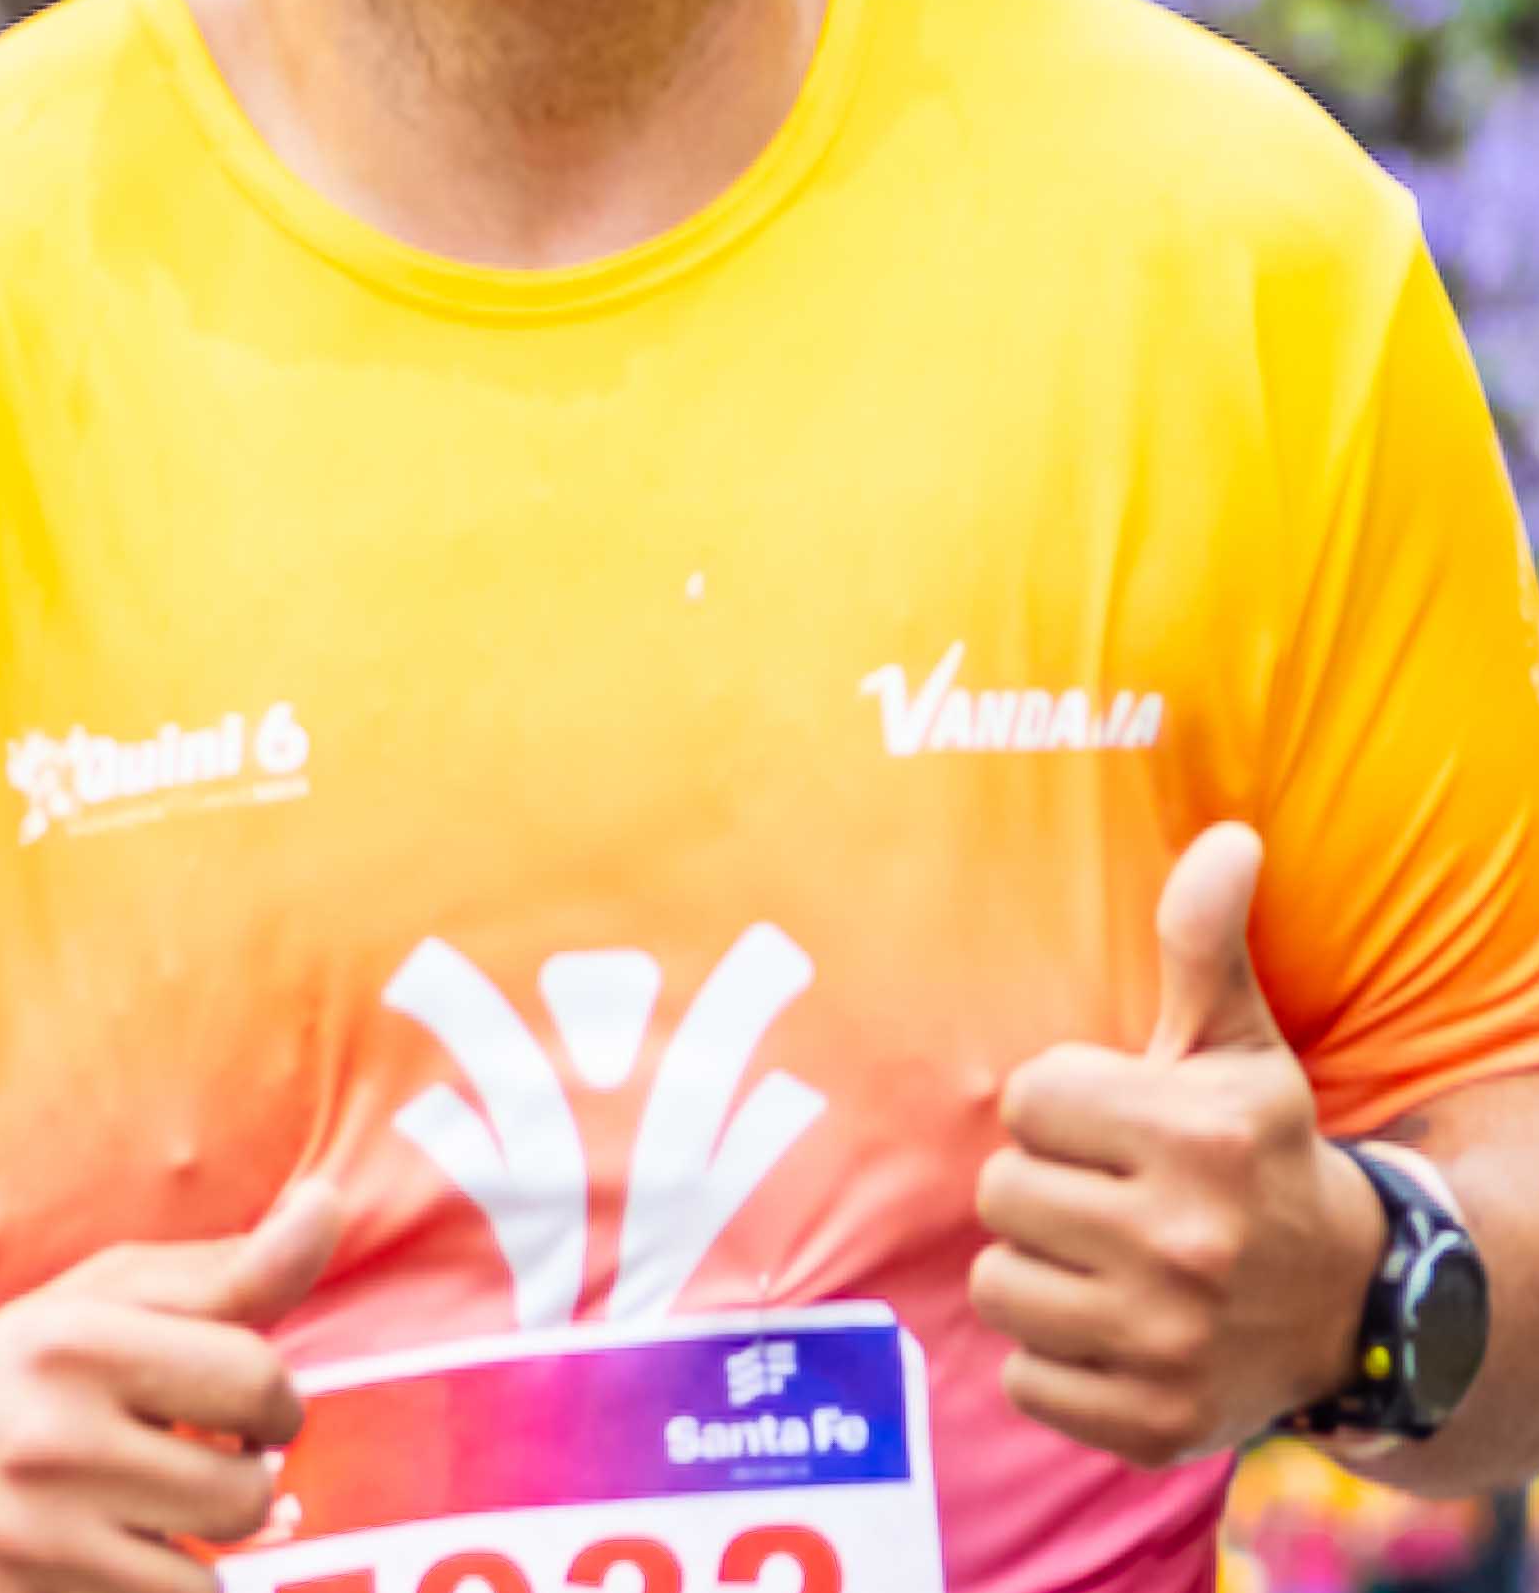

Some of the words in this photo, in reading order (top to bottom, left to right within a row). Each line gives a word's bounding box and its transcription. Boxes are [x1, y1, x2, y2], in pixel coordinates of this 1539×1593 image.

[256, 701, 308, 774] 6
[665, 1413, 811, 1465] Santa
[812, 1405, 870, 1453] Fe
